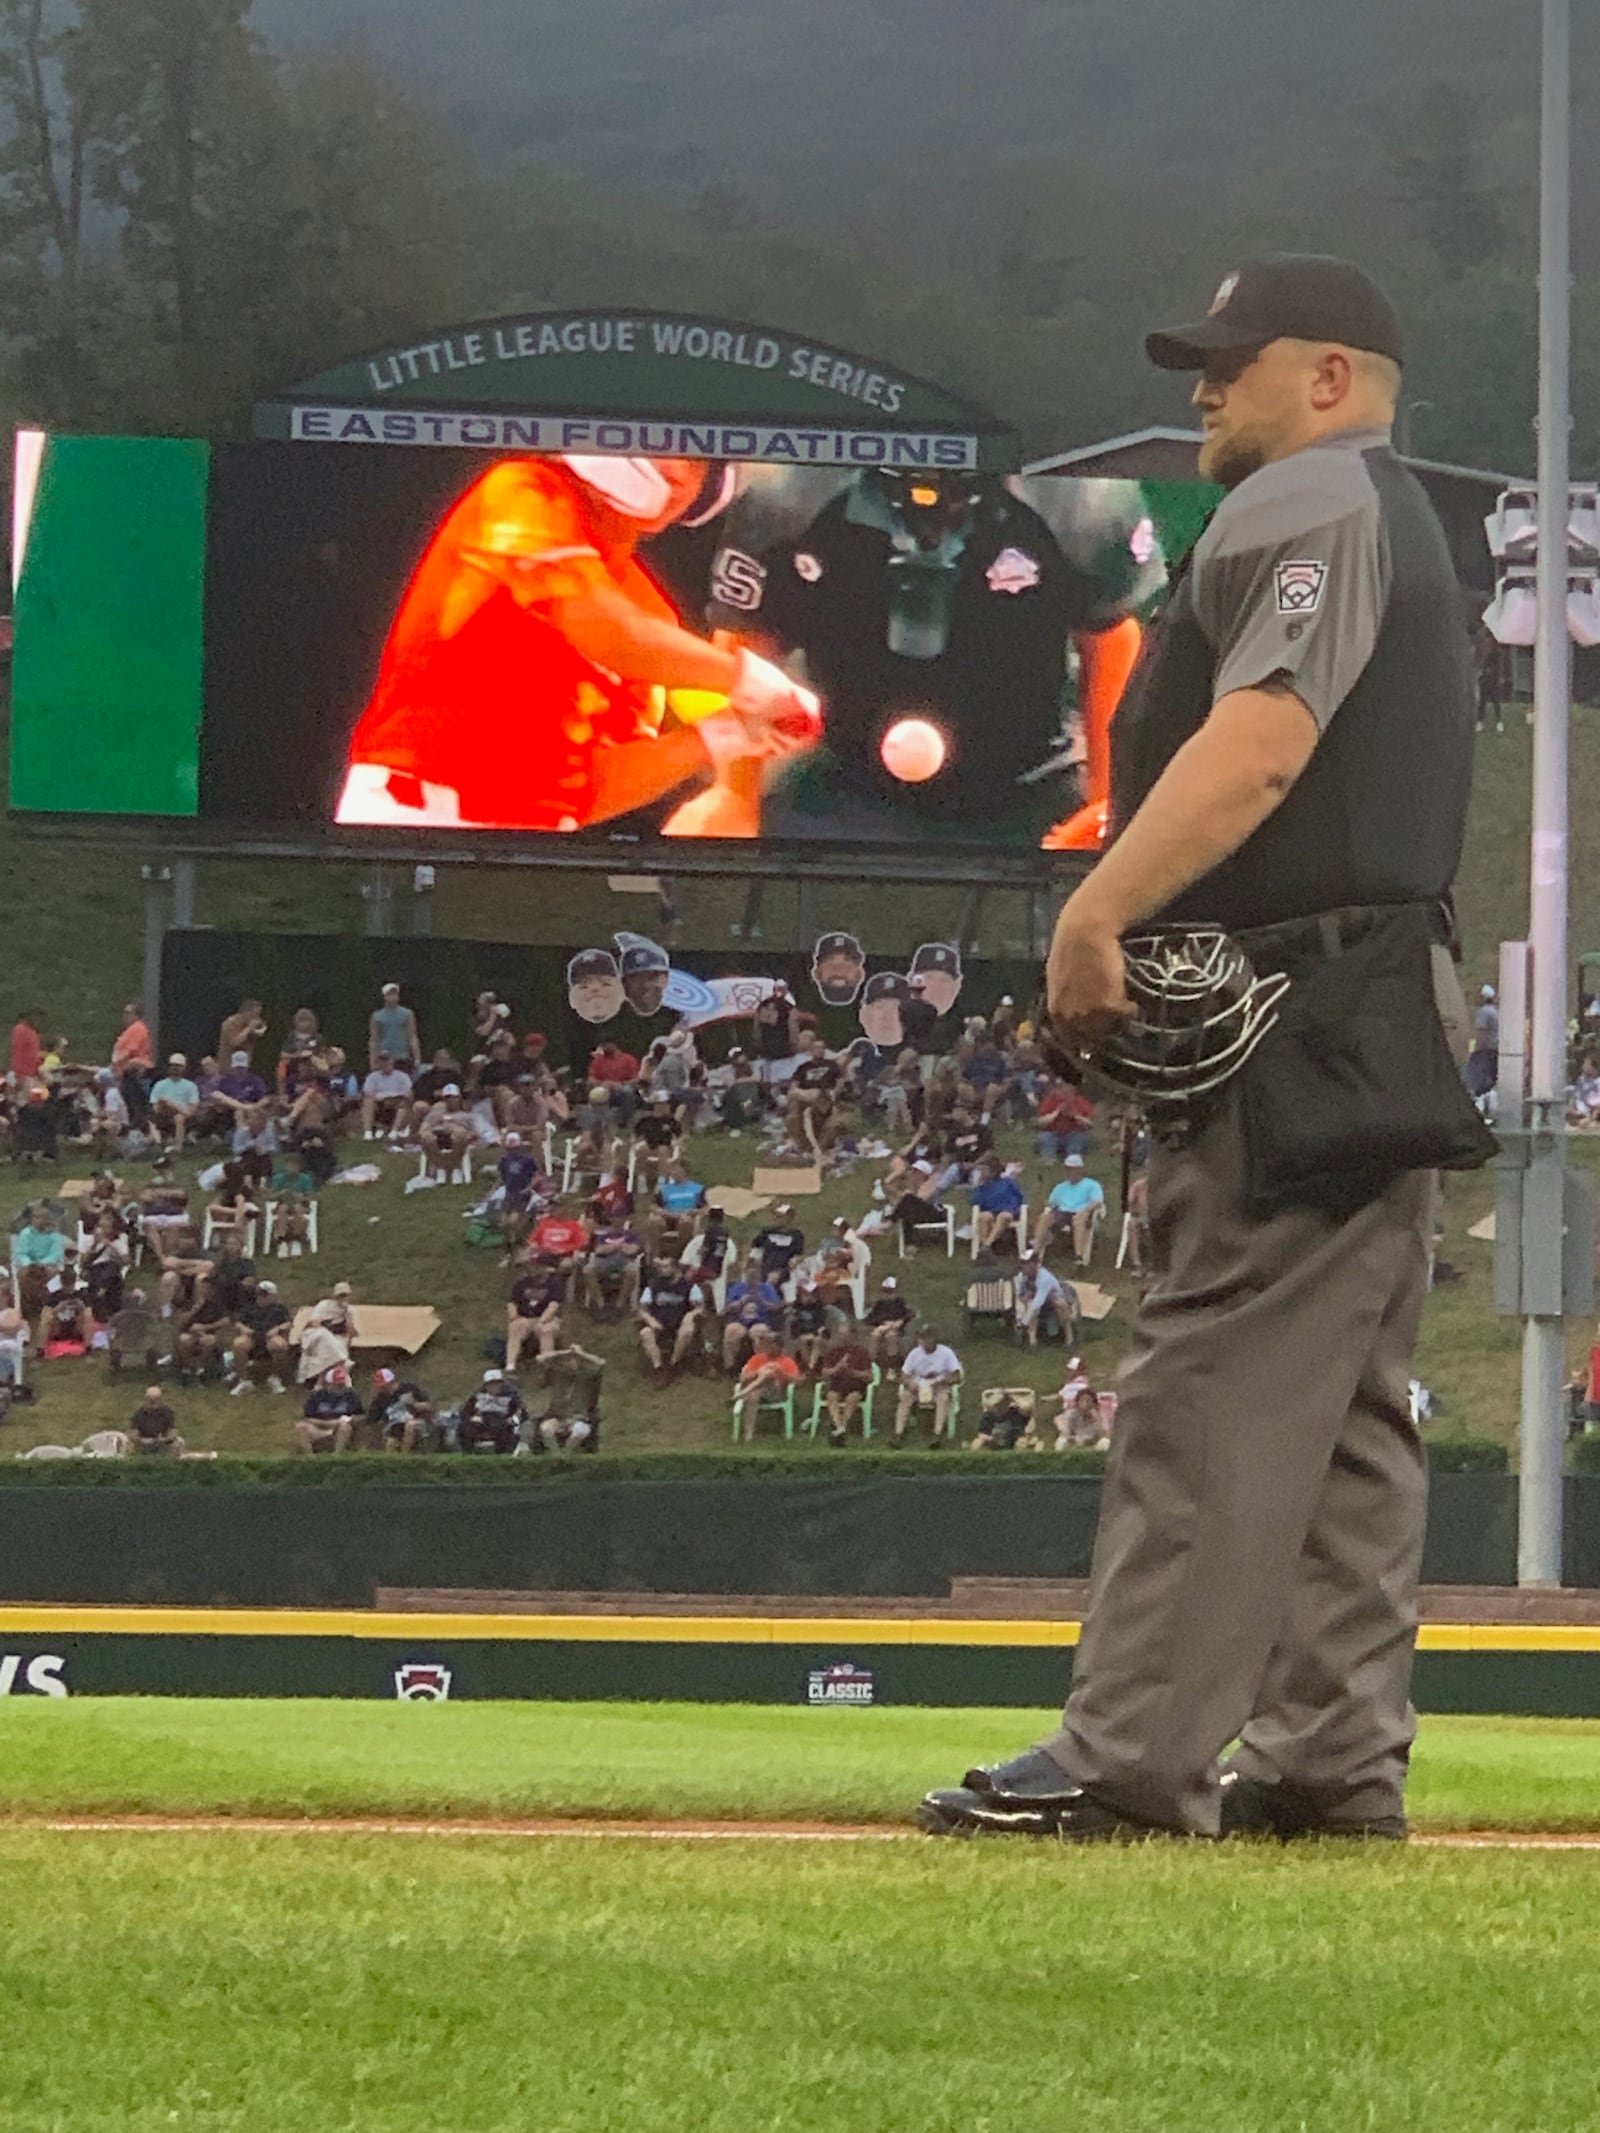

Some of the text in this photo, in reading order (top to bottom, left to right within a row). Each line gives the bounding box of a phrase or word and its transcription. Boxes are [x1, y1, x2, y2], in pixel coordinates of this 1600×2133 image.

[368, 321, 905, 413] LITTLE LEAGUE WORLD SERIES
[301, 411, 967, 465] EASTON FOUNDATIONS
[808, 1682, 873, 1699] CLASSIC
